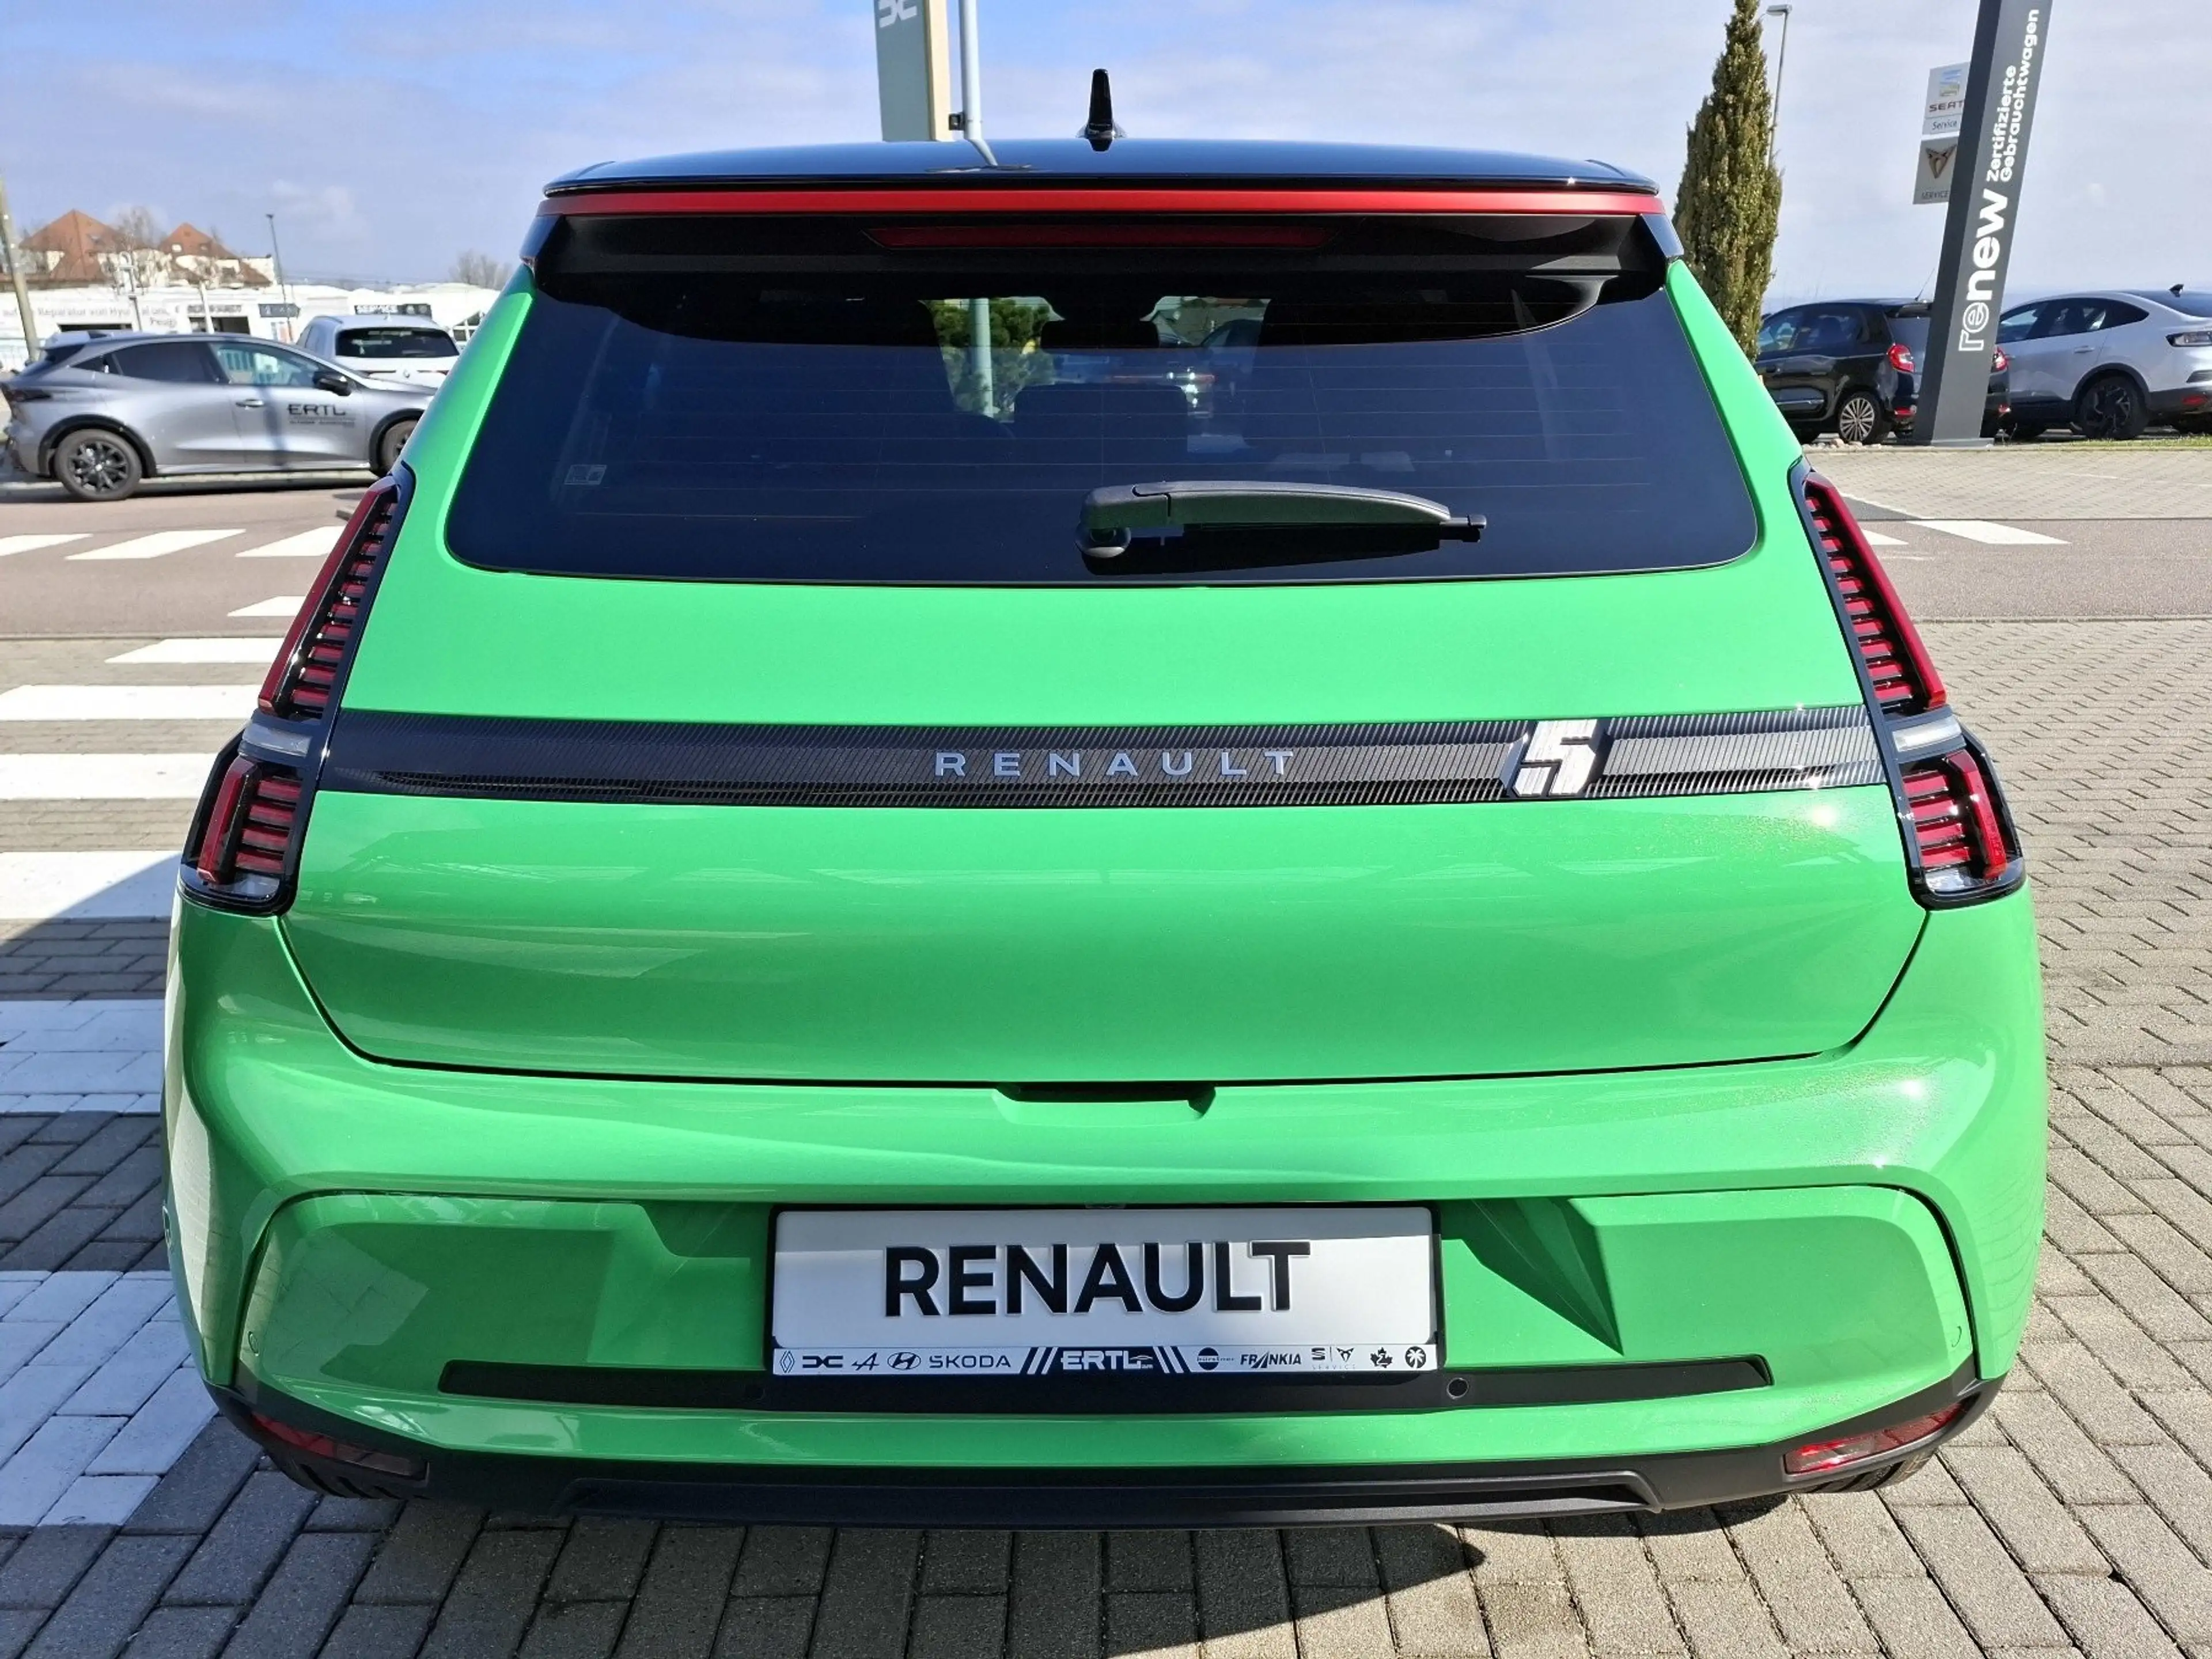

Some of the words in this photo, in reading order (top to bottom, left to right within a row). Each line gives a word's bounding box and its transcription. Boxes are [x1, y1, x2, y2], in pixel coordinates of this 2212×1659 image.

[1929, 100, 1965, 112] SEAT
[2000, 9, 2040, 182] Gebrauchtwagen
[1932, 119, 1957, 130] Service
[1986, 65, 2016, 182] Zertifizierte
[1958, 188, 2008, 351] renew
[287, 404, 346, 415] ERTL
[934, 751, 1293, 777] RENAULT
[1513, 719, 1598, 796] 5
[885, 1240, 1311, 1317] RENAULT
[1060, 1350, 1141, 1370] ERTL
[1240, 1351, 1301, 1369] FRANKIA
